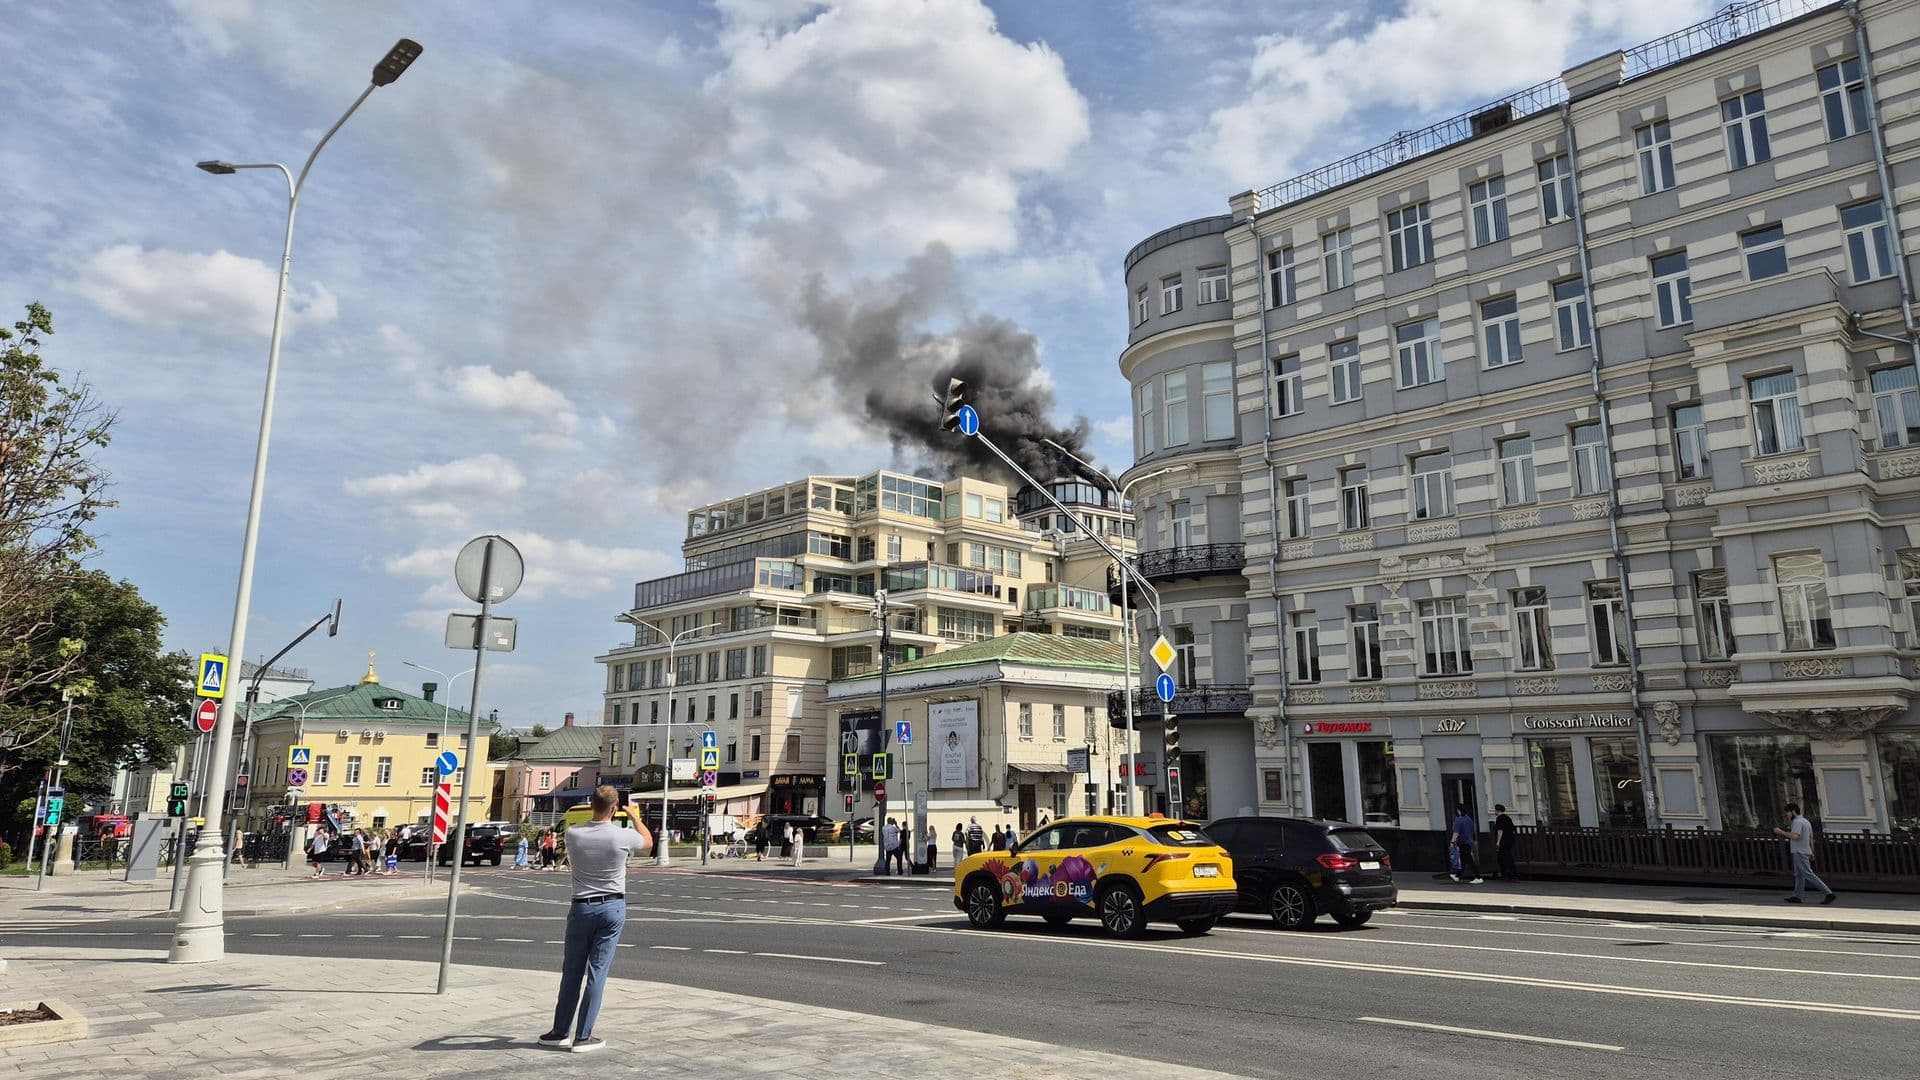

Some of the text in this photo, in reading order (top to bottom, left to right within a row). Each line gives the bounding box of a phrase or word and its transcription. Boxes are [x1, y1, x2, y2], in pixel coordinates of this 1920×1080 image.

[1316, 720, 1372, 734] Теремок
[1524, 714, 1633, 729] Croissant Atelier
[173, 785, 187, 797] 05
[1021, 882, 1087, 898] Яндекс Еда
